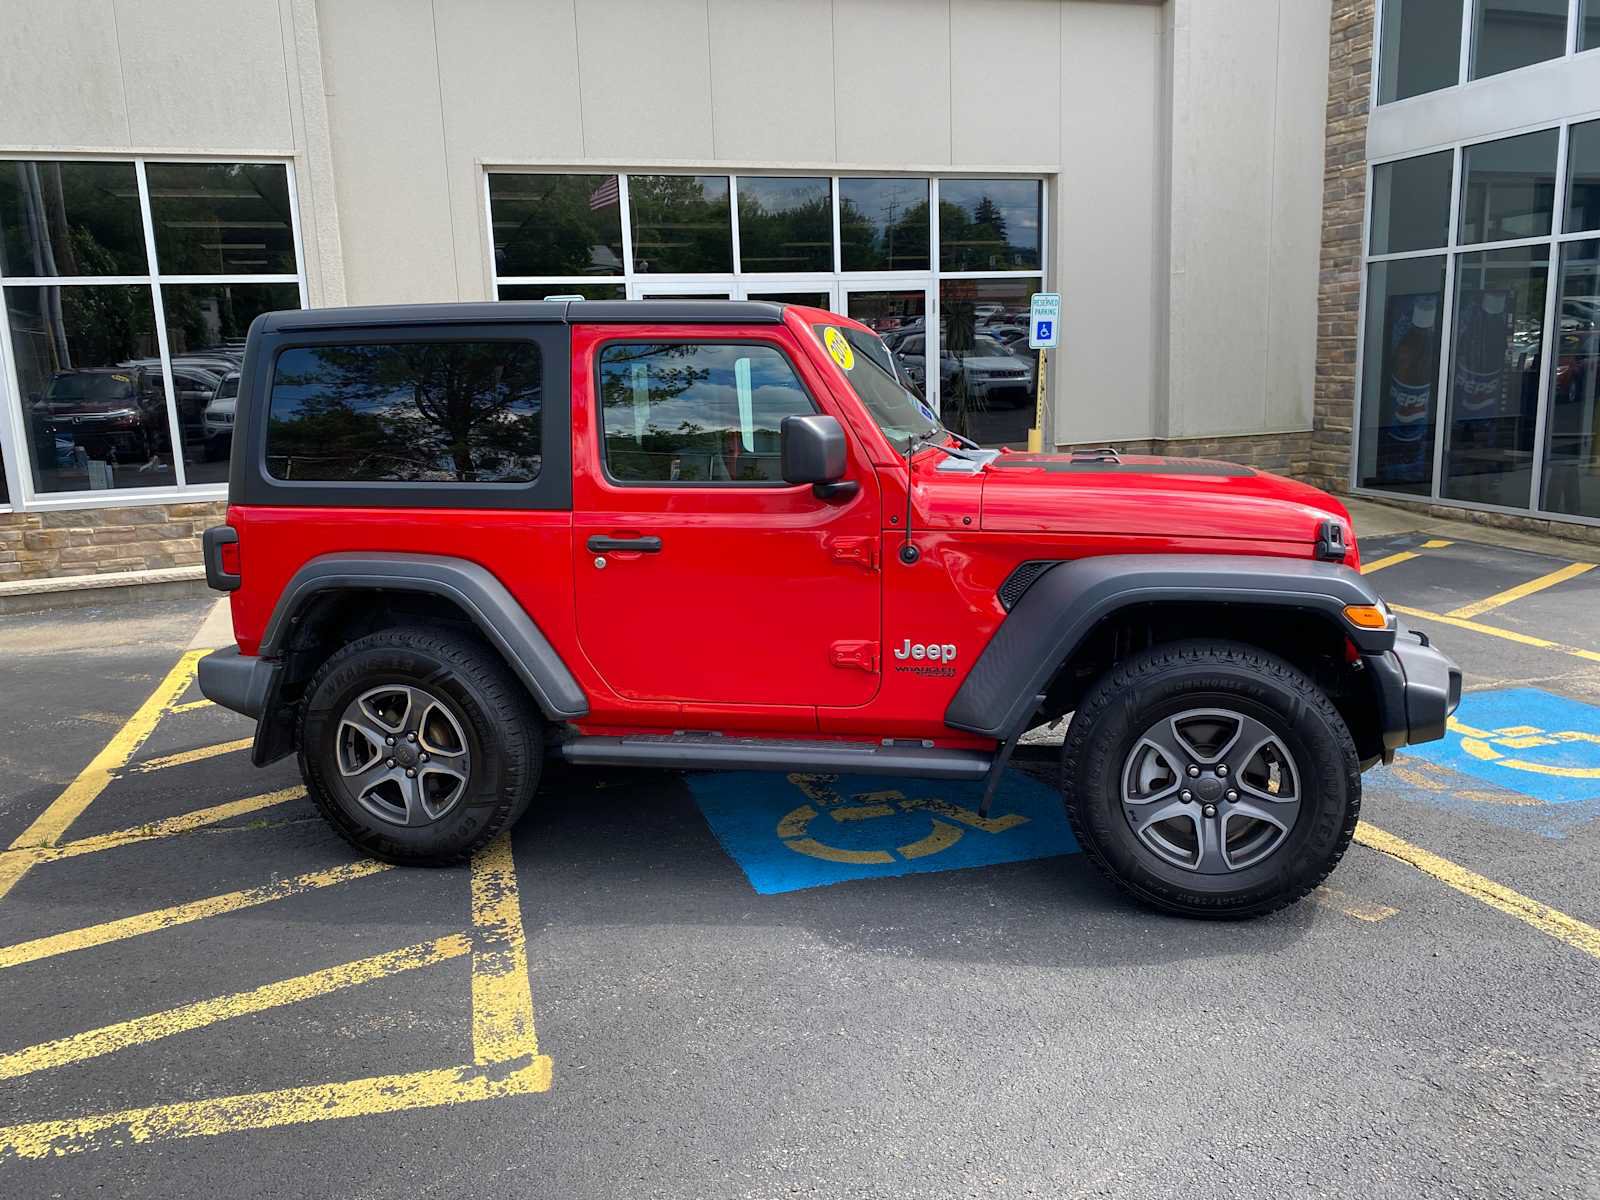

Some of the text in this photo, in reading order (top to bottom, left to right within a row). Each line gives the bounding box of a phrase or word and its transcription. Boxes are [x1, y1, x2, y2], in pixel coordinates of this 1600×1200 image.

[1032, 298, 1059, 306] RESERVED
[894, 639, 957, 664] Jeep
[324, 657, 416, 696] WRANER
[895, 666, 956, 674] WRANGLER
